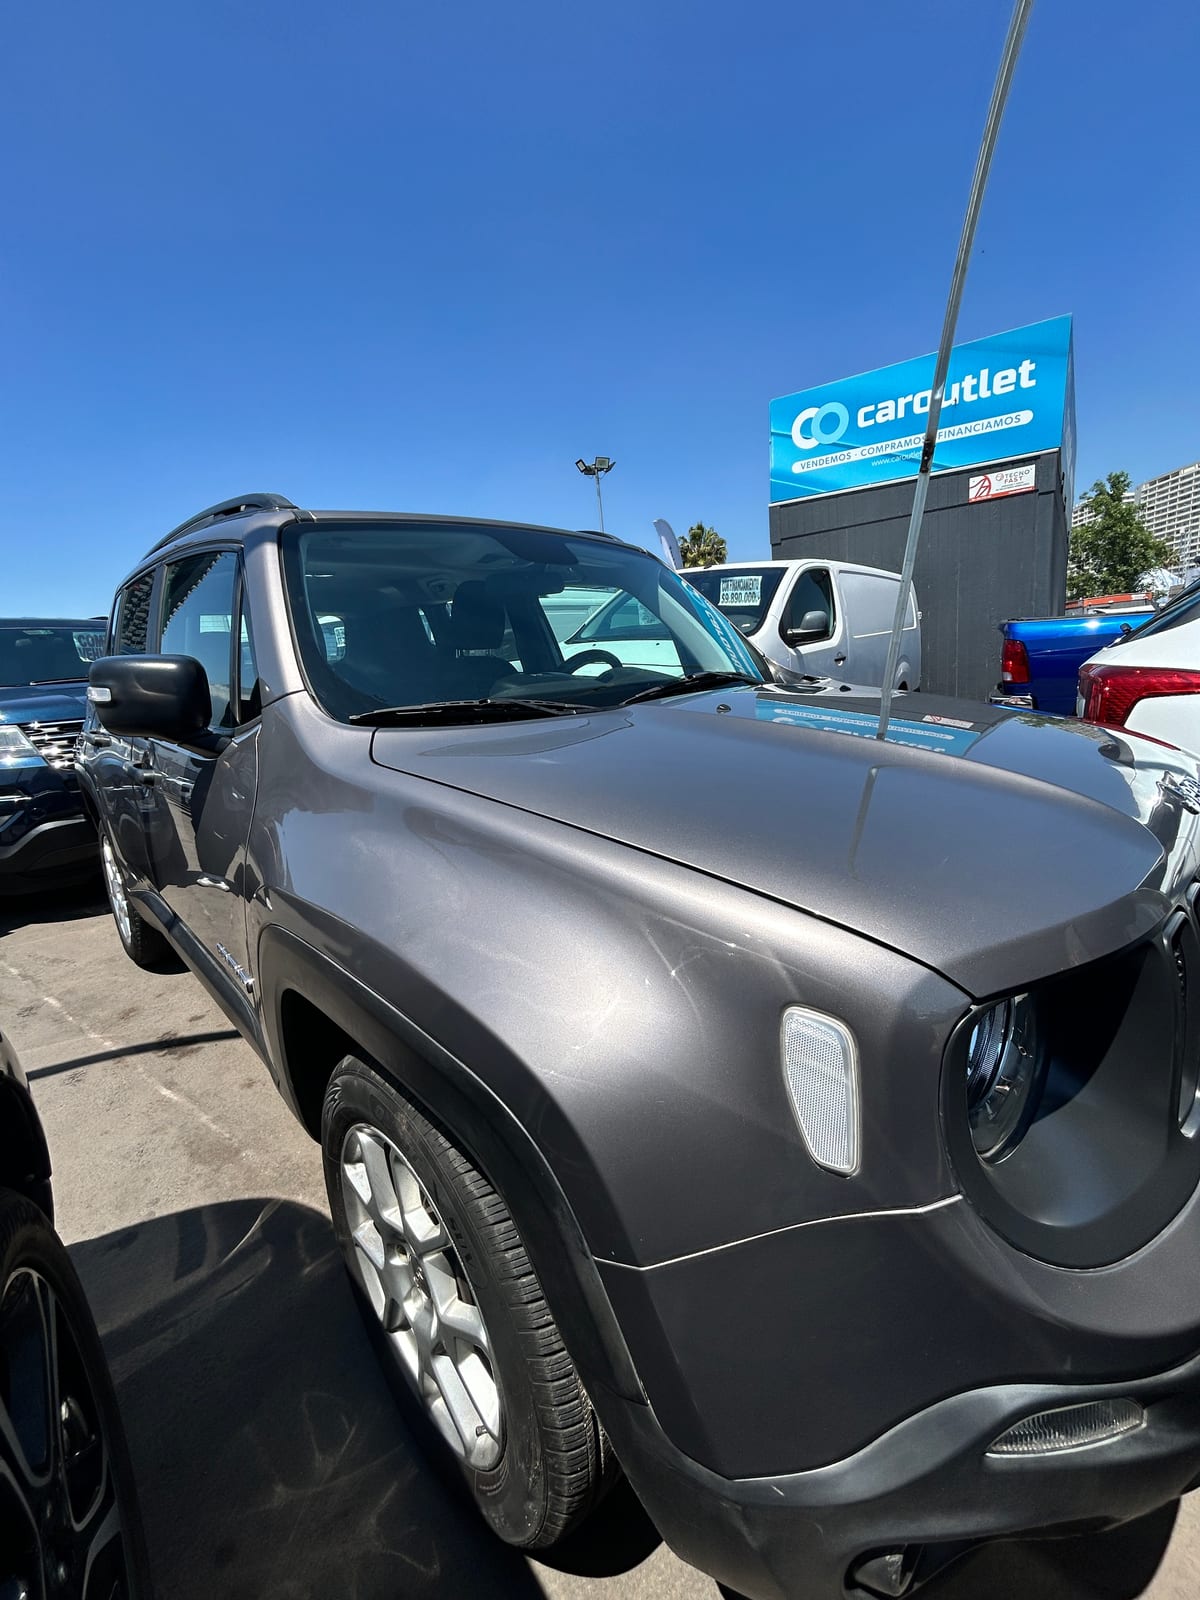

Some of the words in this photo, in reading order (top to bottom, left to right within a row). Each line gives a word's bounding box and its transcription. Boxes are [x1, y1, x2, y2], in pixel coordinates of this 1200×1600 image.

[857, 359, 1037, 428] caroutlet
[800, 452, 852, 470] VENDEMOS
[938, 414, 1021, 440] FINANCIAMOS
[1004, 469, 1030, 479] TECNO
[1004, 476, 1023, 484] FAST
